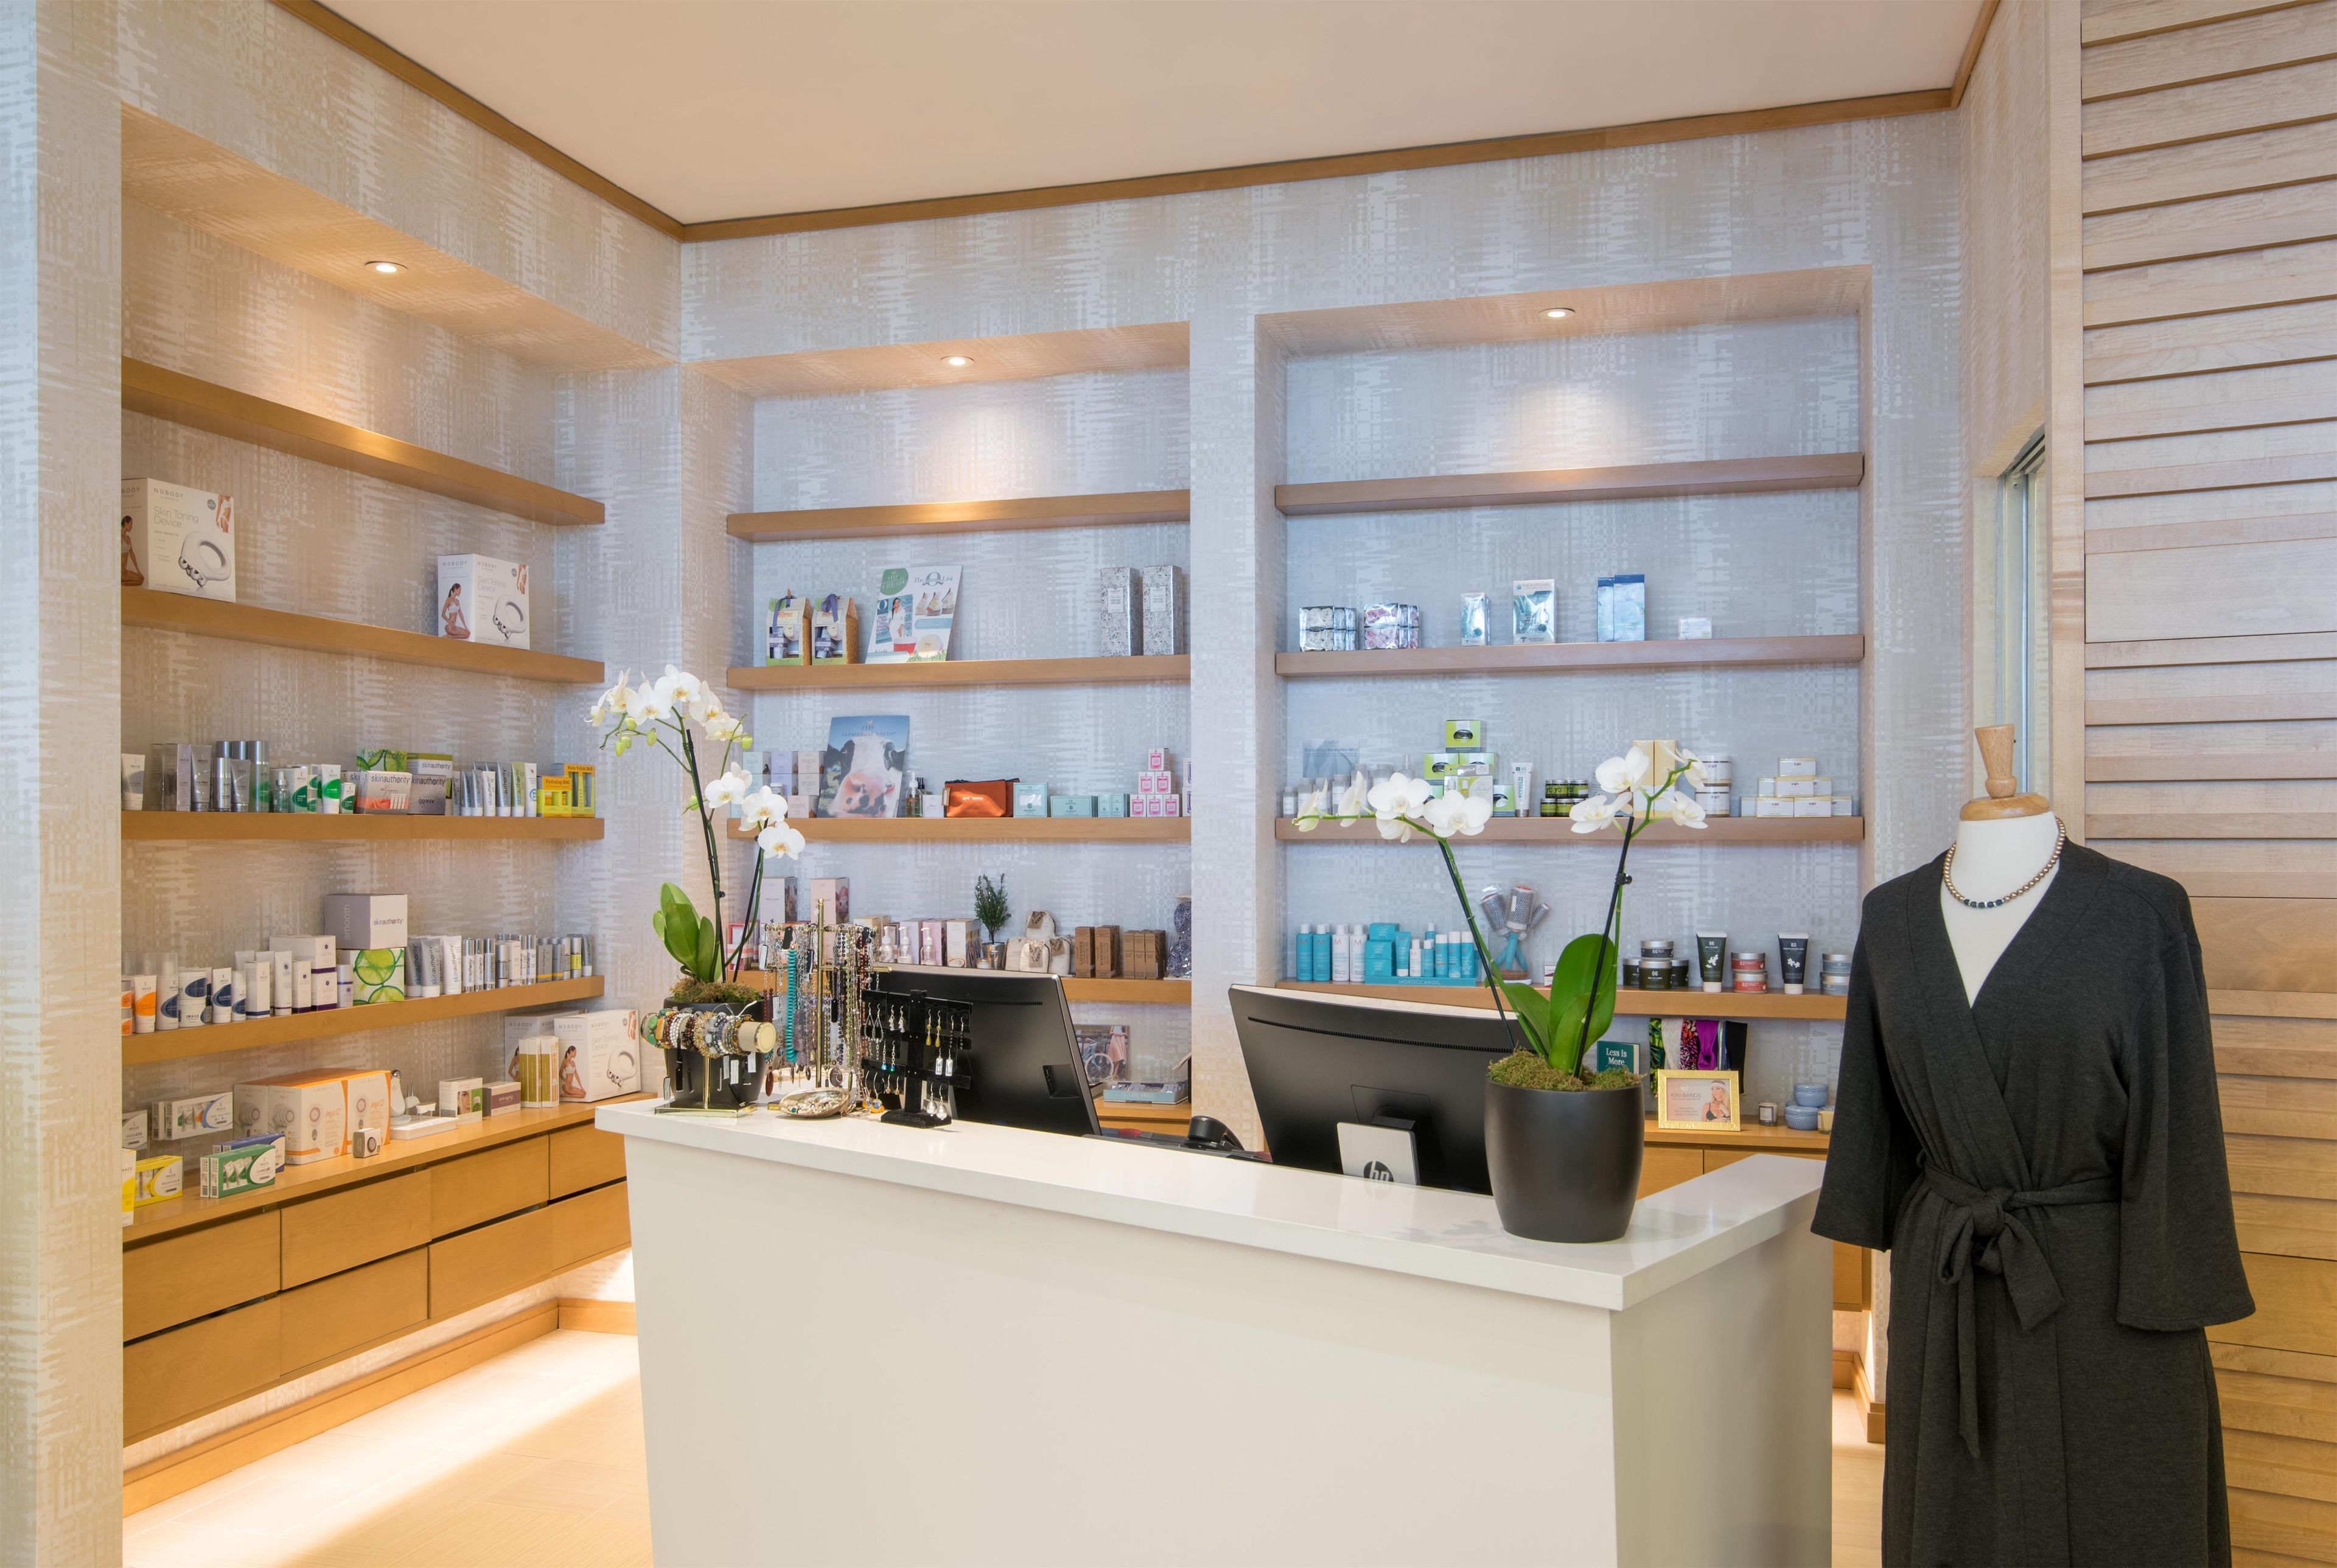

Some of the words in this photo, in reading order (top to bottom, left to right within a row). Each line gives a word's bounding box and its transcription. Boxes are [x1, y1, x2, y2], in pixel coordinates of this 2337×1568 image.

[154, 506, 171, 517] Skin
[173, 510, 198, 524] Toning
[154, 515, 182, 528] Device
[478, 576, 489, 584] Skin
[882, 580, 905, 589] FRESH
[371, 773, 409, 785] skinauthority
[412, 776, 445, 787] kinauthority
[429, 944, 438, 984] skinauthority
[450, 944, 459, 983] skinauthority
[1605, 1048, 1619, 1057] Less
[1621, 1049, 1627, 1058] is
[1608, 1057, 1626, 1066] More
